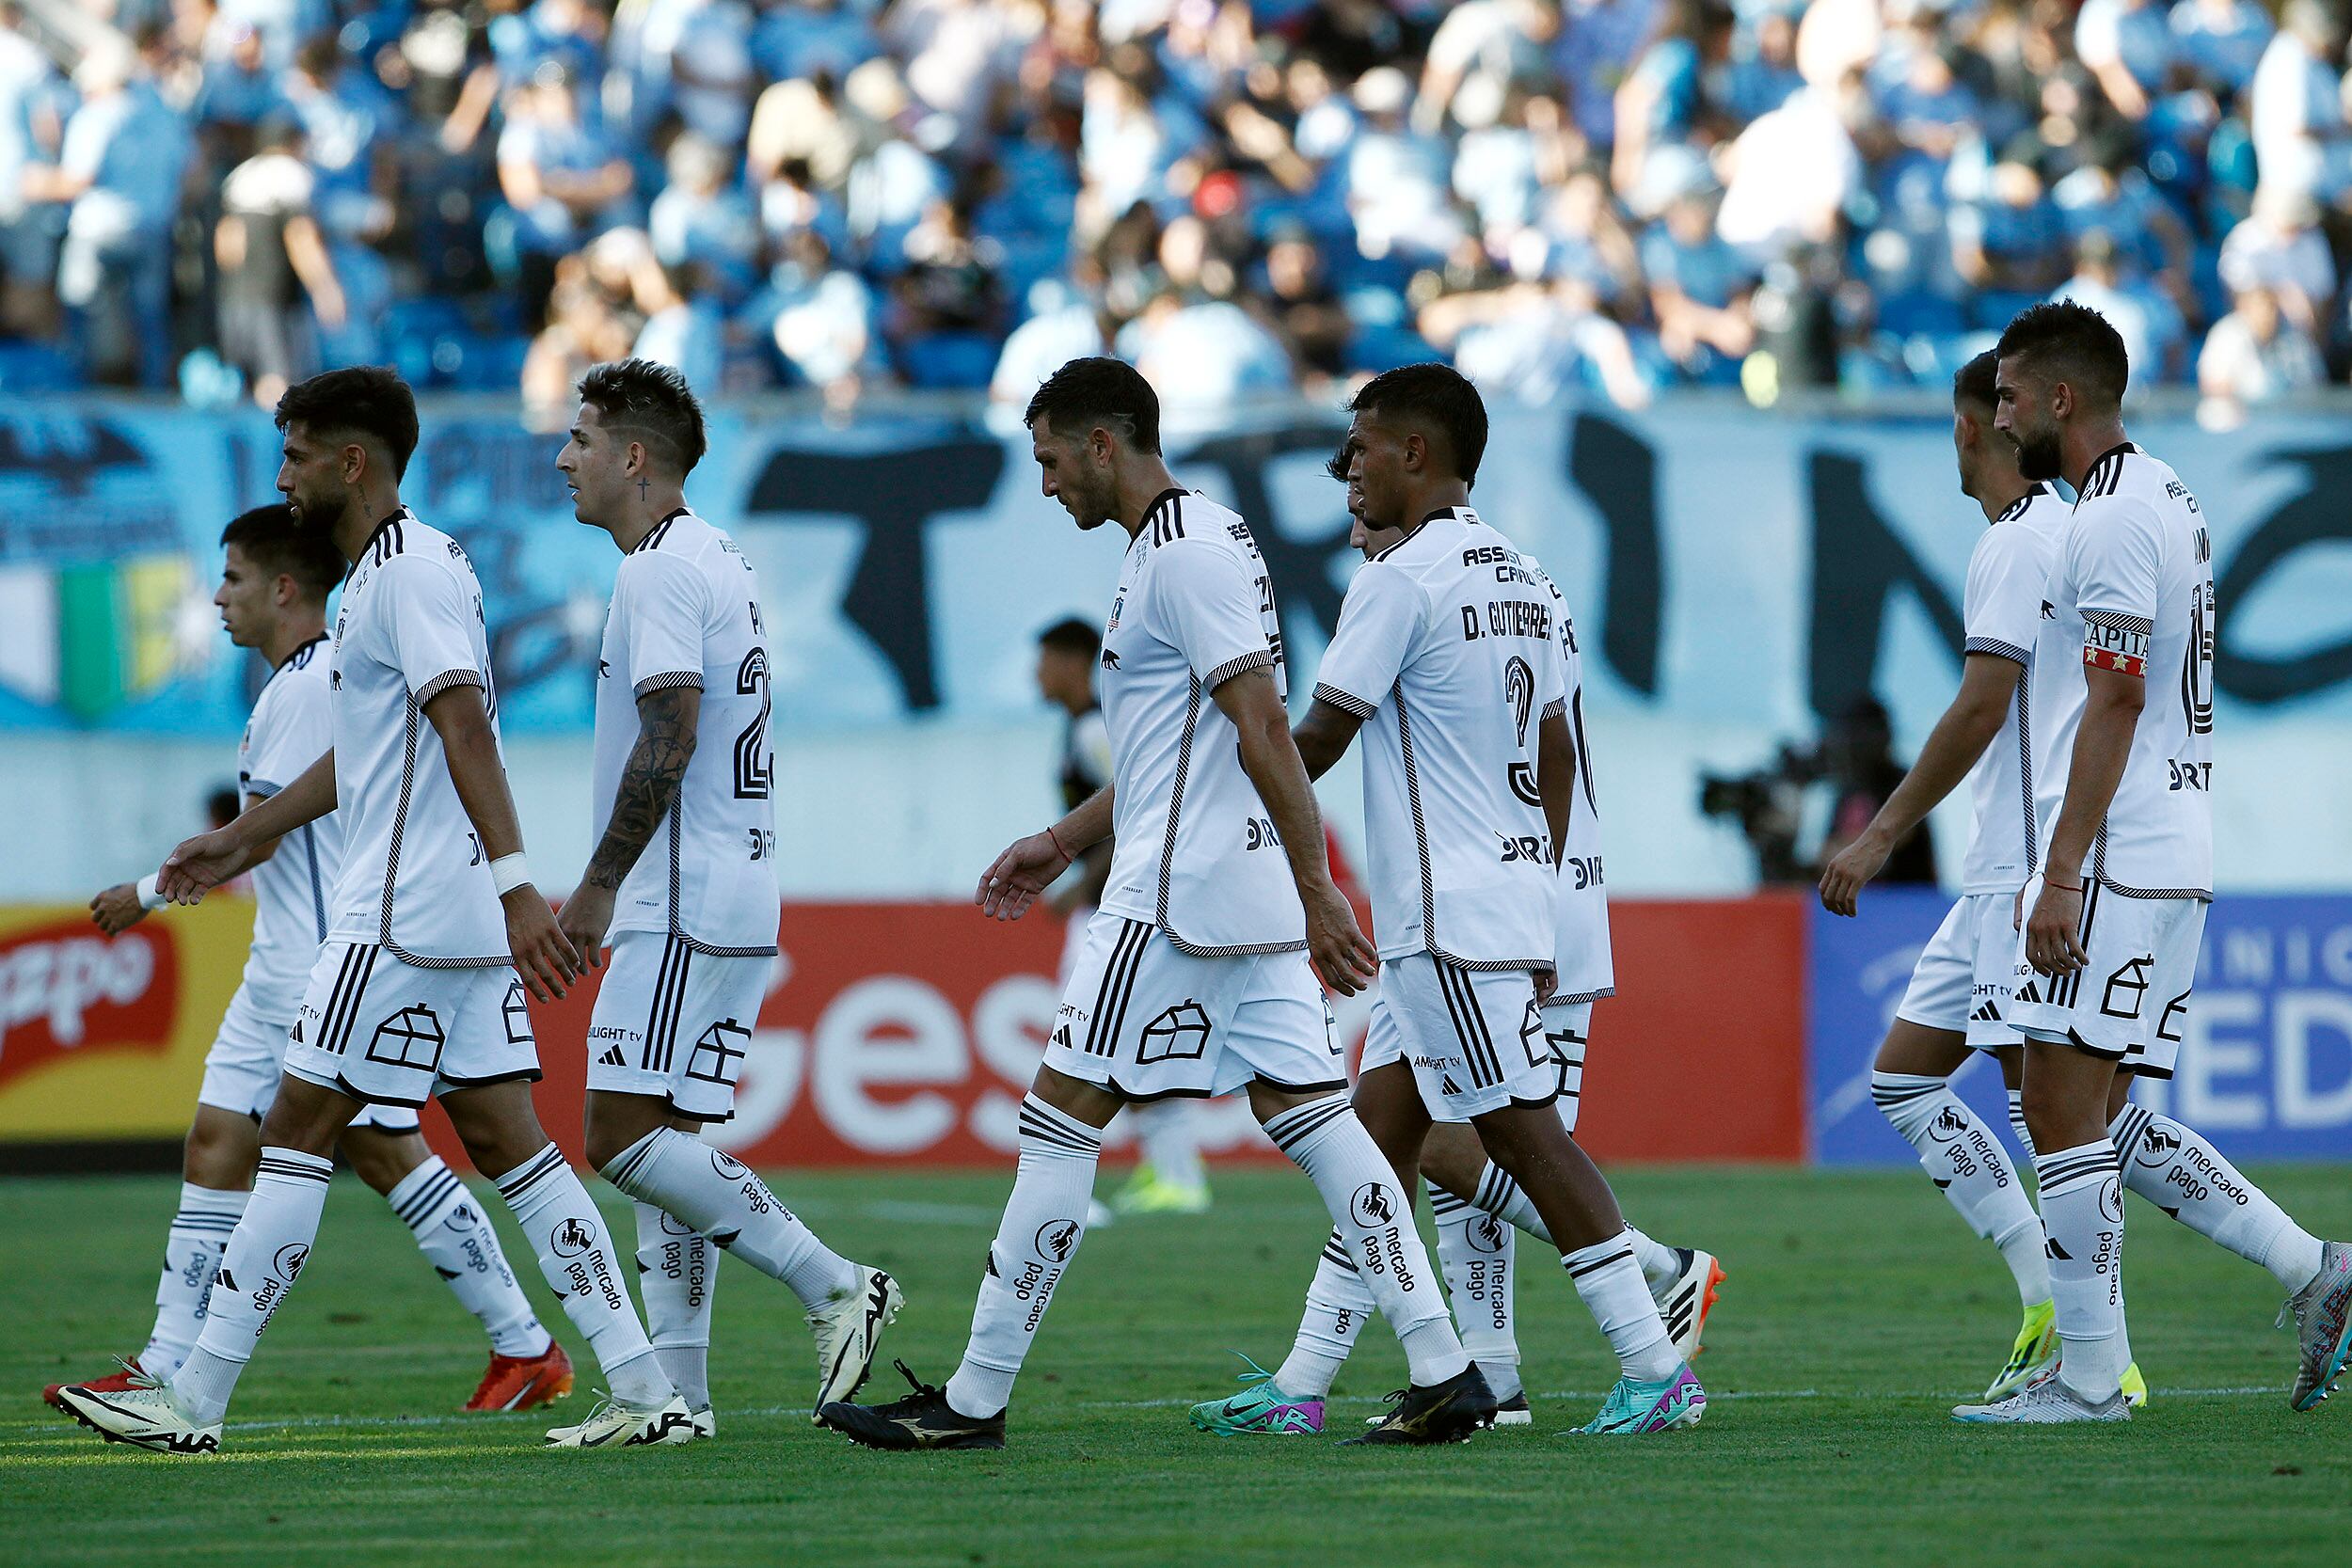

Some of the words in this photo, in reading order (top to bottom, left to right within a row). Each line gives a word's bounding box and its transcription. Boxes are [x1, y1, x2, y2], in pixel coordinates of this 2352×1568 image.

[1461, 605, 1486, 641] D.
[1945, 1143, 1978, 1177] pago
[1967, 1130, 2009, 1188] mercado
[2184, 1146, 2249, 1206] mercado
[740, 1181, 770, 1214] pago
[2165, 1164, 2208, 1201] pago
[183, 1252, 207, 1288] pago
[460, 1238, 489, 1274] pago
[660, 1241, 682, 1279] pago
[689, 1236, 706, 1307] mercado
[1360, 1235, 1386, 1275] pago
[1385, 1226, 1415, 1292] mercado
[2091, 1230, 2114, 1275] pago
[252, 1276, 280, 1311] pago
[564, 1261, 594, 1297] pago
[587, 1249, 622, 1311] mercado
[1013, 1260, 1043, 1301] pago
[1466, 1259, 1486, 1301] pago
[1491, 1259, 1508, 1330] mercado
[1024, 1268, 1061, 1332] mercado
